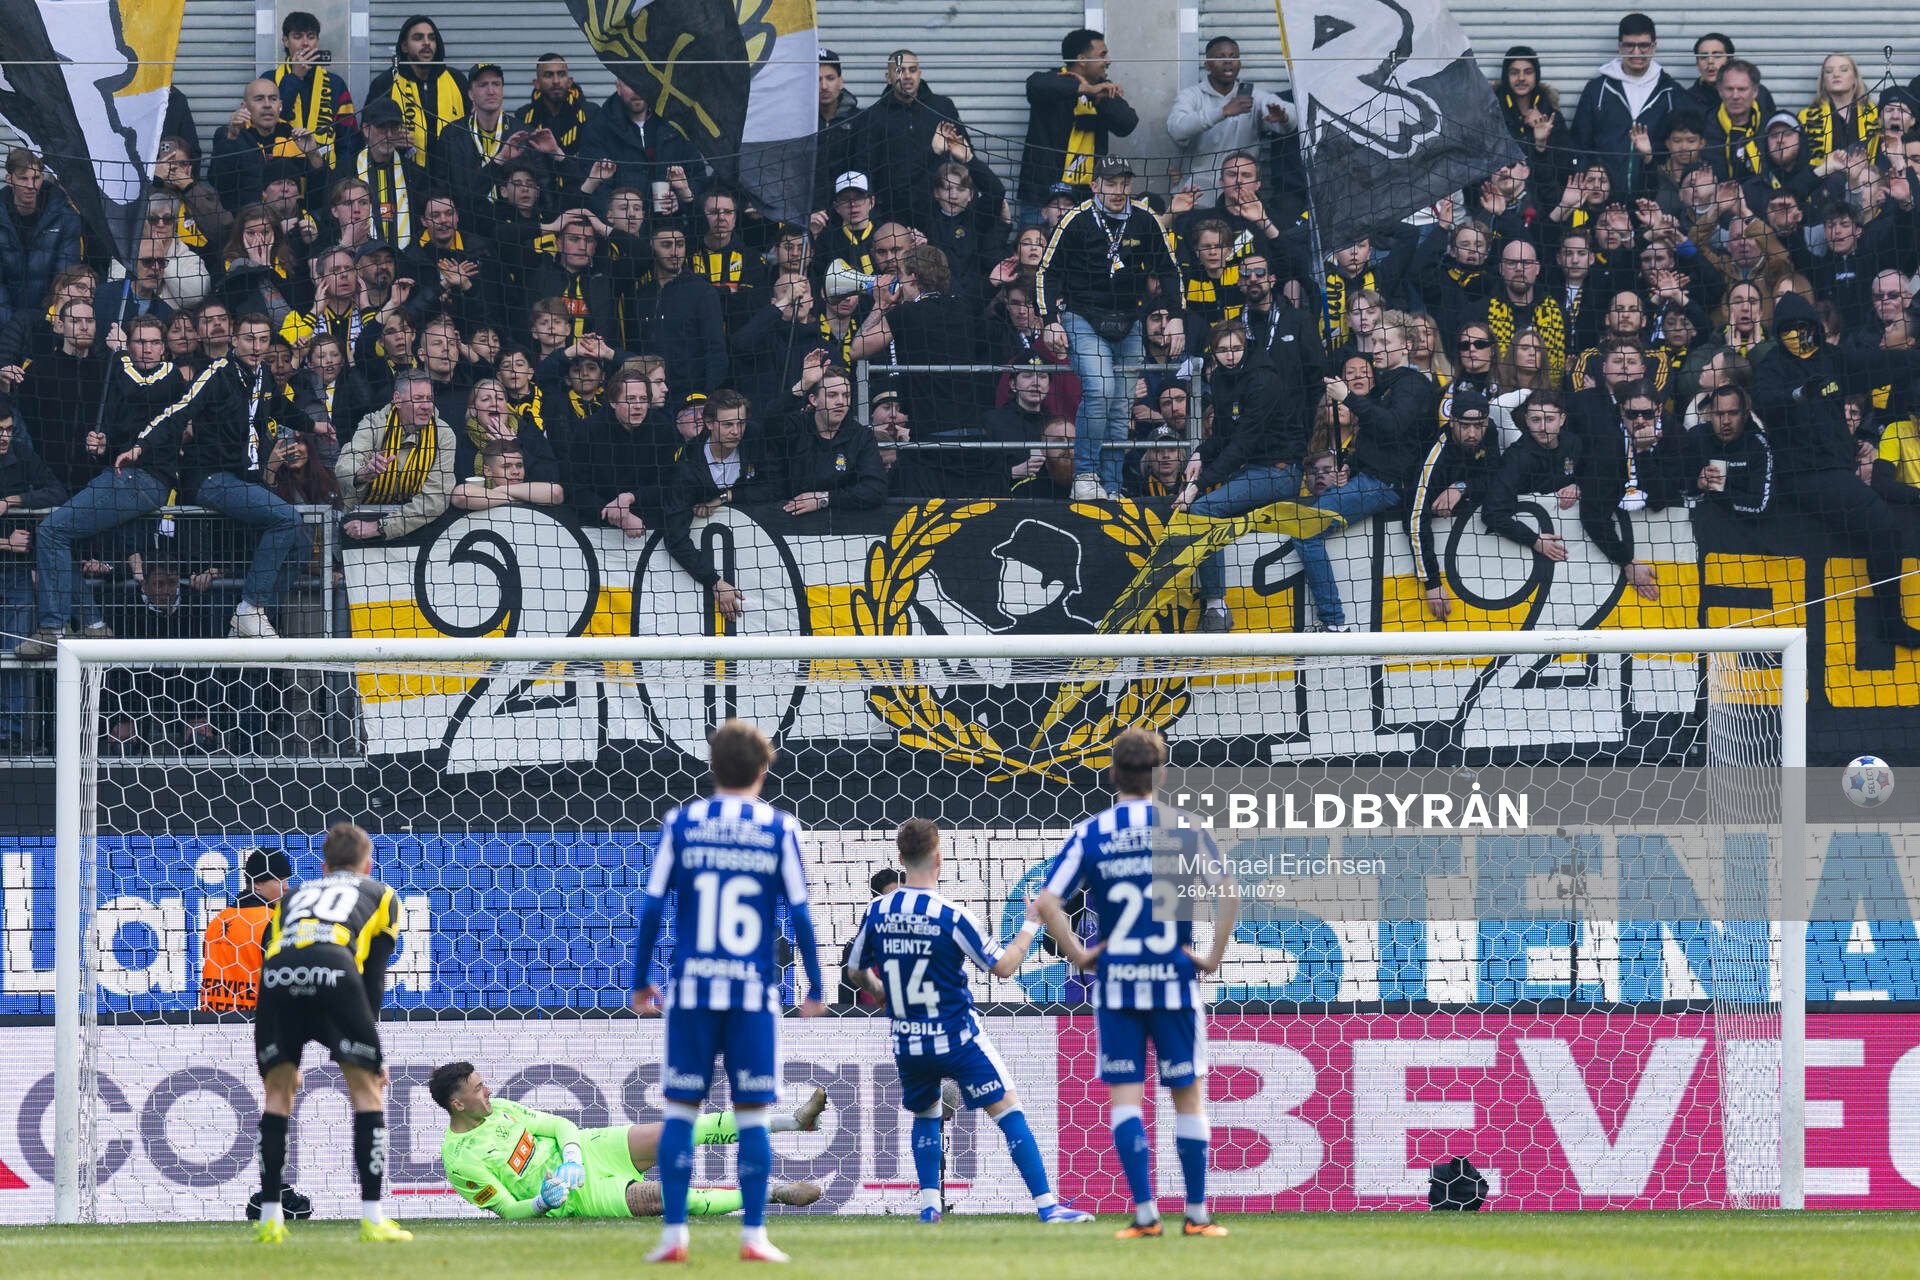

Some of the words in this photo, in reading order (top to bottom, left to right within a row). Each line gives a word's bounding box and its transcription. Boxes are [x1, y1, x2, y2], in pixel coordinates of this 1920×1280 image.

[1865, 768, 1876, 795] SELECT
[285, 885, 360, 926] 20
[693, 871, 763, 957] 16
[1107, 880, 1181, 956] 23
[875, 923, 941, 936] WELLNESS
[884, 913, 929, 925] NORDIC
[883, 938, 932, 955] HEINTZ
[201, 978, 257, 1000] ERVICE
[264, 965, 346, 988] boomr
[883, 958, 941, 1019] 14
